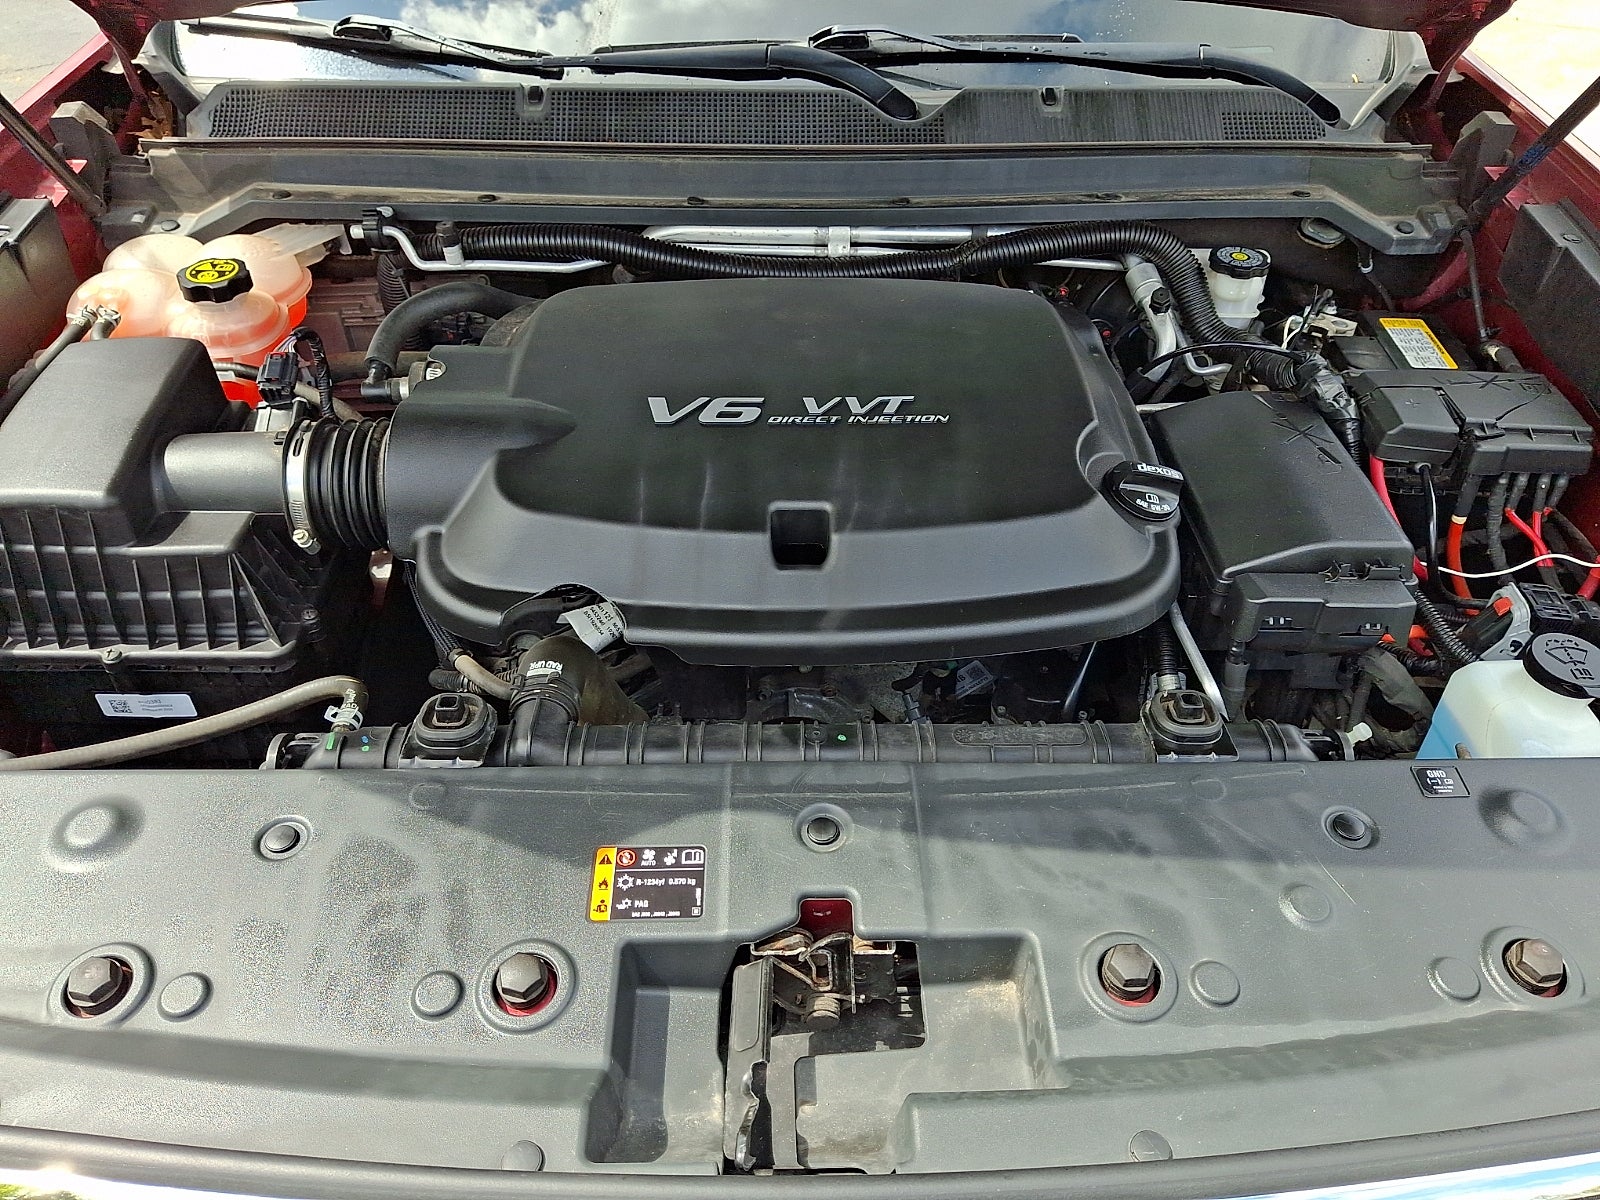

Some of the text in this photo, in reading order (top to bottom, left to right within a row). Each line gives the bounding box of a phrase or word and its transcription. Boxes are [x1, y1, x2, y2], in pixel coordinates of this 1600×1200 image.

[647, 397, 765, 424] V6
[802, 396, 915, 415] VVT
[767, 415, 950, 425] DIRECT INJECTION
[530, 660, 562, 670] RAD UPR
[635, 878, 665, 886] R-1234yf
[687, 877, 696, 886] kg
